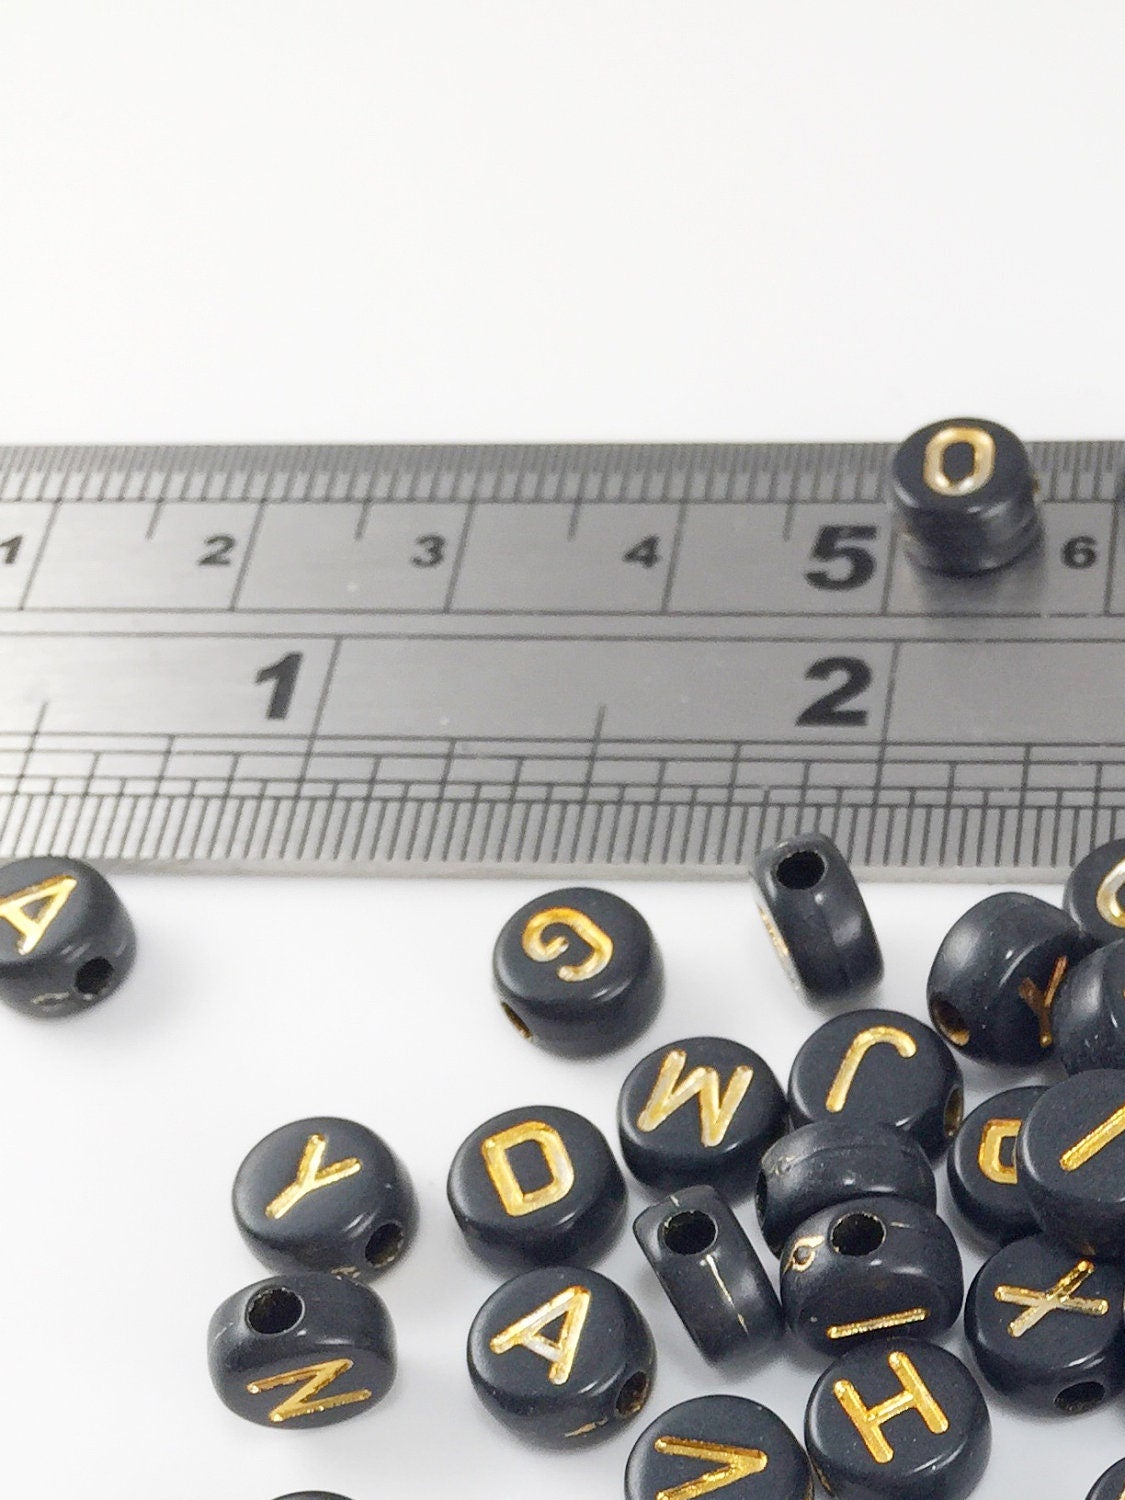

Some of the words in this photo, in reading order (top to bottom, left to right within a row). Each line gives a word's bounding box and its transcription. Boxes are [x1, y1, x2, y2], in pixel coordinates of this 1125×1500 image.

[199, 535, 236, 566] 2
[412, 535, 446, 567] 3
[624, 535, 661, 568] 4
[805, 525, 877, 591] 5
[1060, 535, 1098, 569] 6
[255, 651, 303, 720] 1
[795, 656, 873, 727] 2
[0, 876, 76, 953] A
[522, 907, 613, 981] G
[266, 1134, 360, 1217] Y
[481, 1121, 574, 1216] D
[490, 1286, 590, 1382] A
[995, 1260, 1108, 1336] X
[834, 1352, 949, 1463] H
